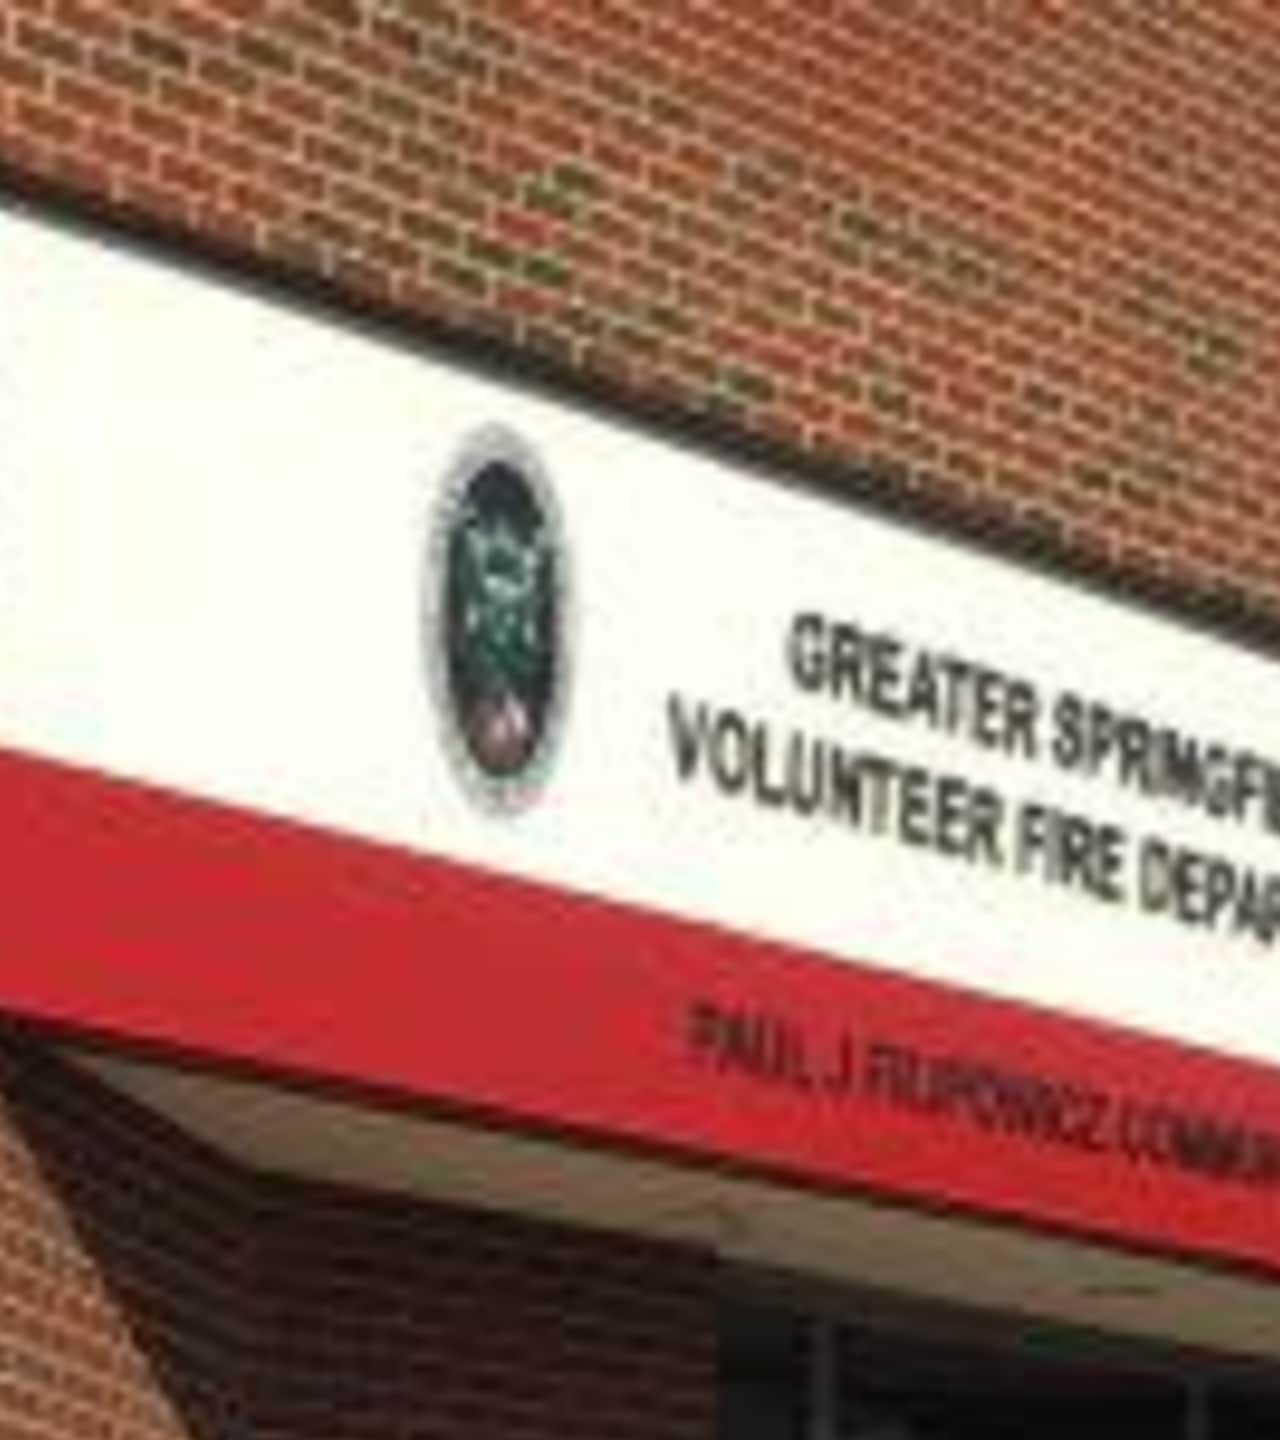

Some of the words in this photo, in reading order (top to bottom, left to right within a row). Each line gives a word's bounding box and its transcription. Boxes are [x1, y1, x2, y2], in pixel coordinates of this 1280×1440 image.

[787, 610, 1037, 760] GREATER
[668, 692, 1004, 866] VOLUNTEER
[1017, 800, 1125, 904] FIRE
[690, 1002, 813, 1094] PAUL
